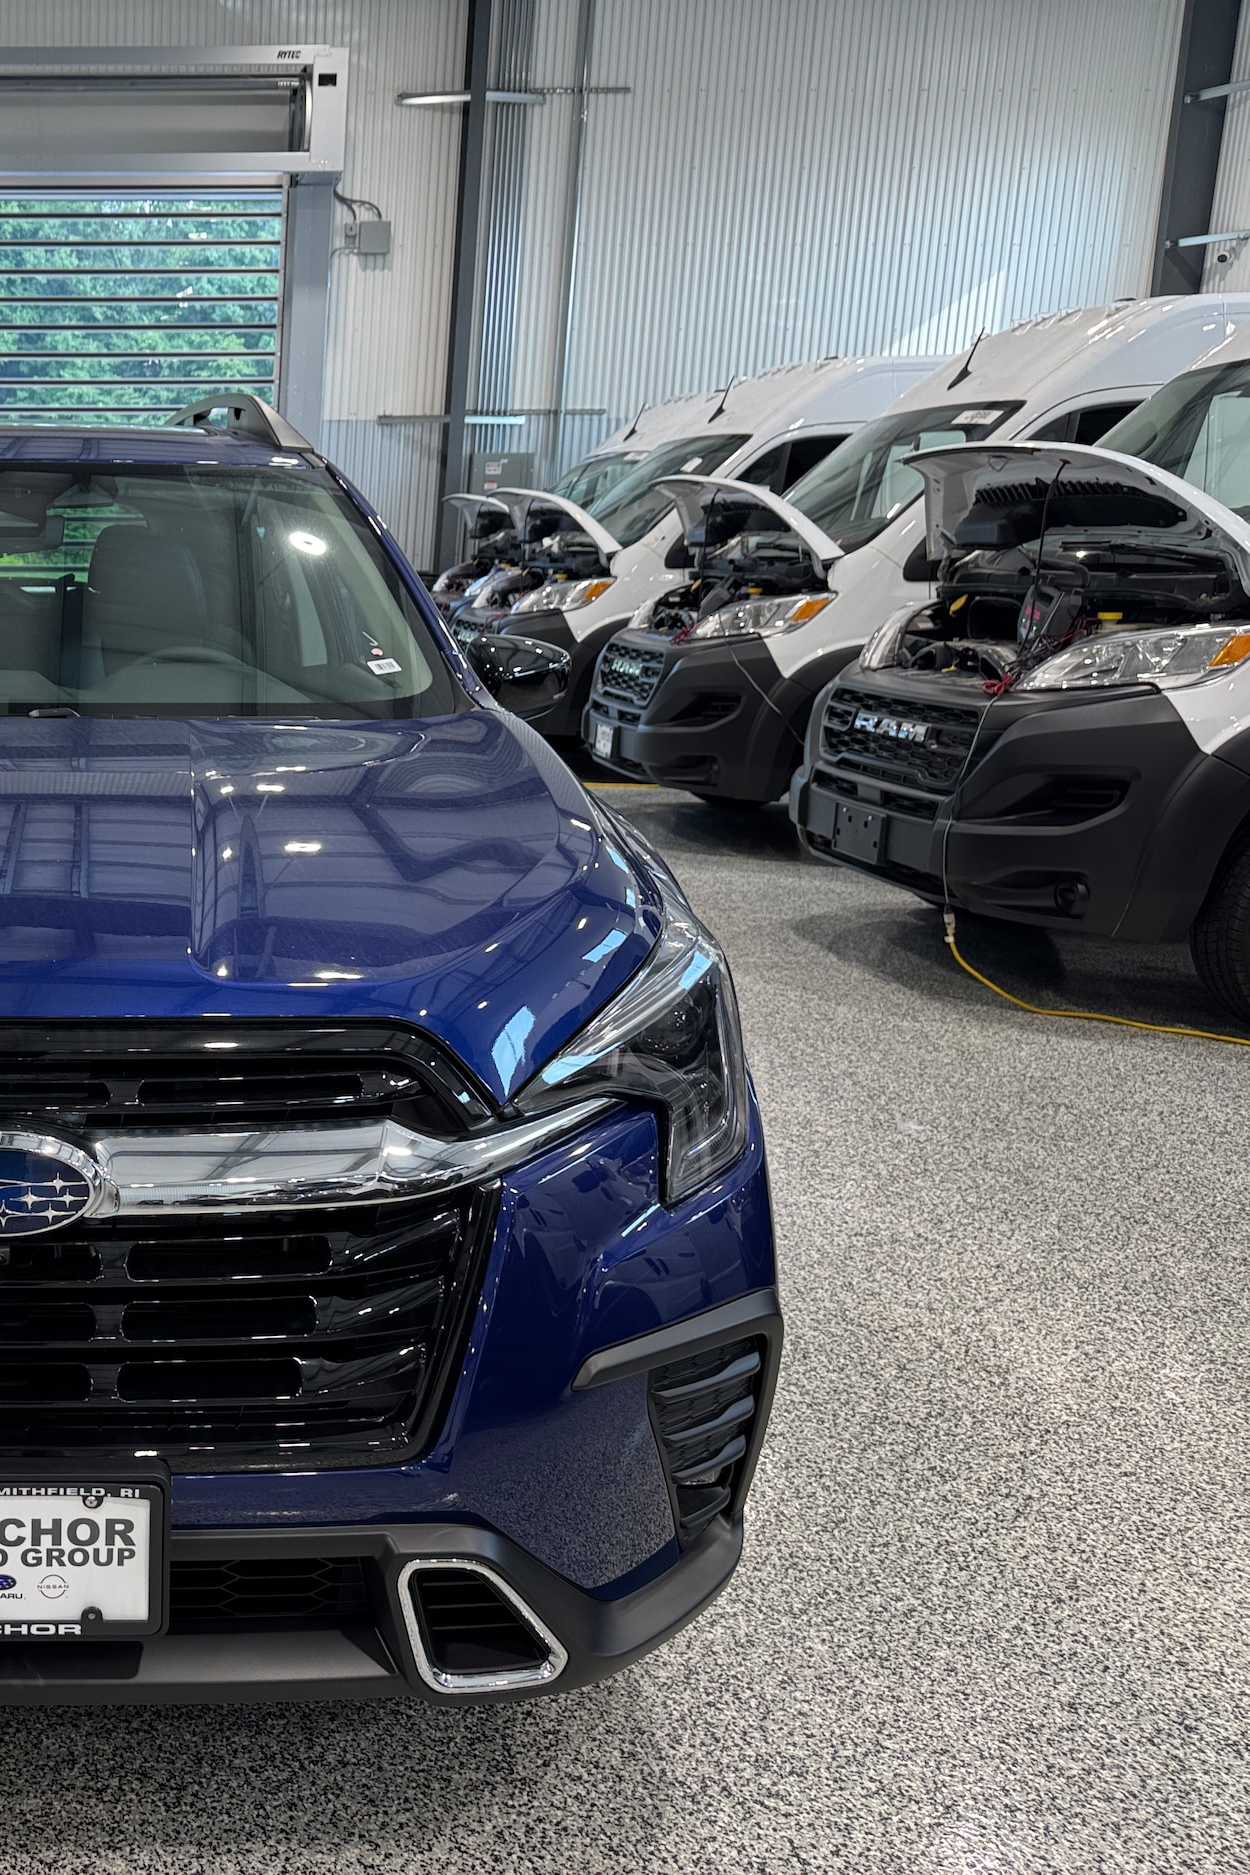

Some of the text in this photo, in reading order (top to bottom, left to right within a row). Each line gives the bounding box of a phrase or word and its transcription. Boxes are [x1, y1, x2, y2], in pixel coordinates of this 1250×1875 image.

[277, 50, 301, 59] RYTEC
[854, 711, 928, 742] RAM
[120, 1488, 140, 1498] RI
[20, 1547, 136, 1567] GROUP
